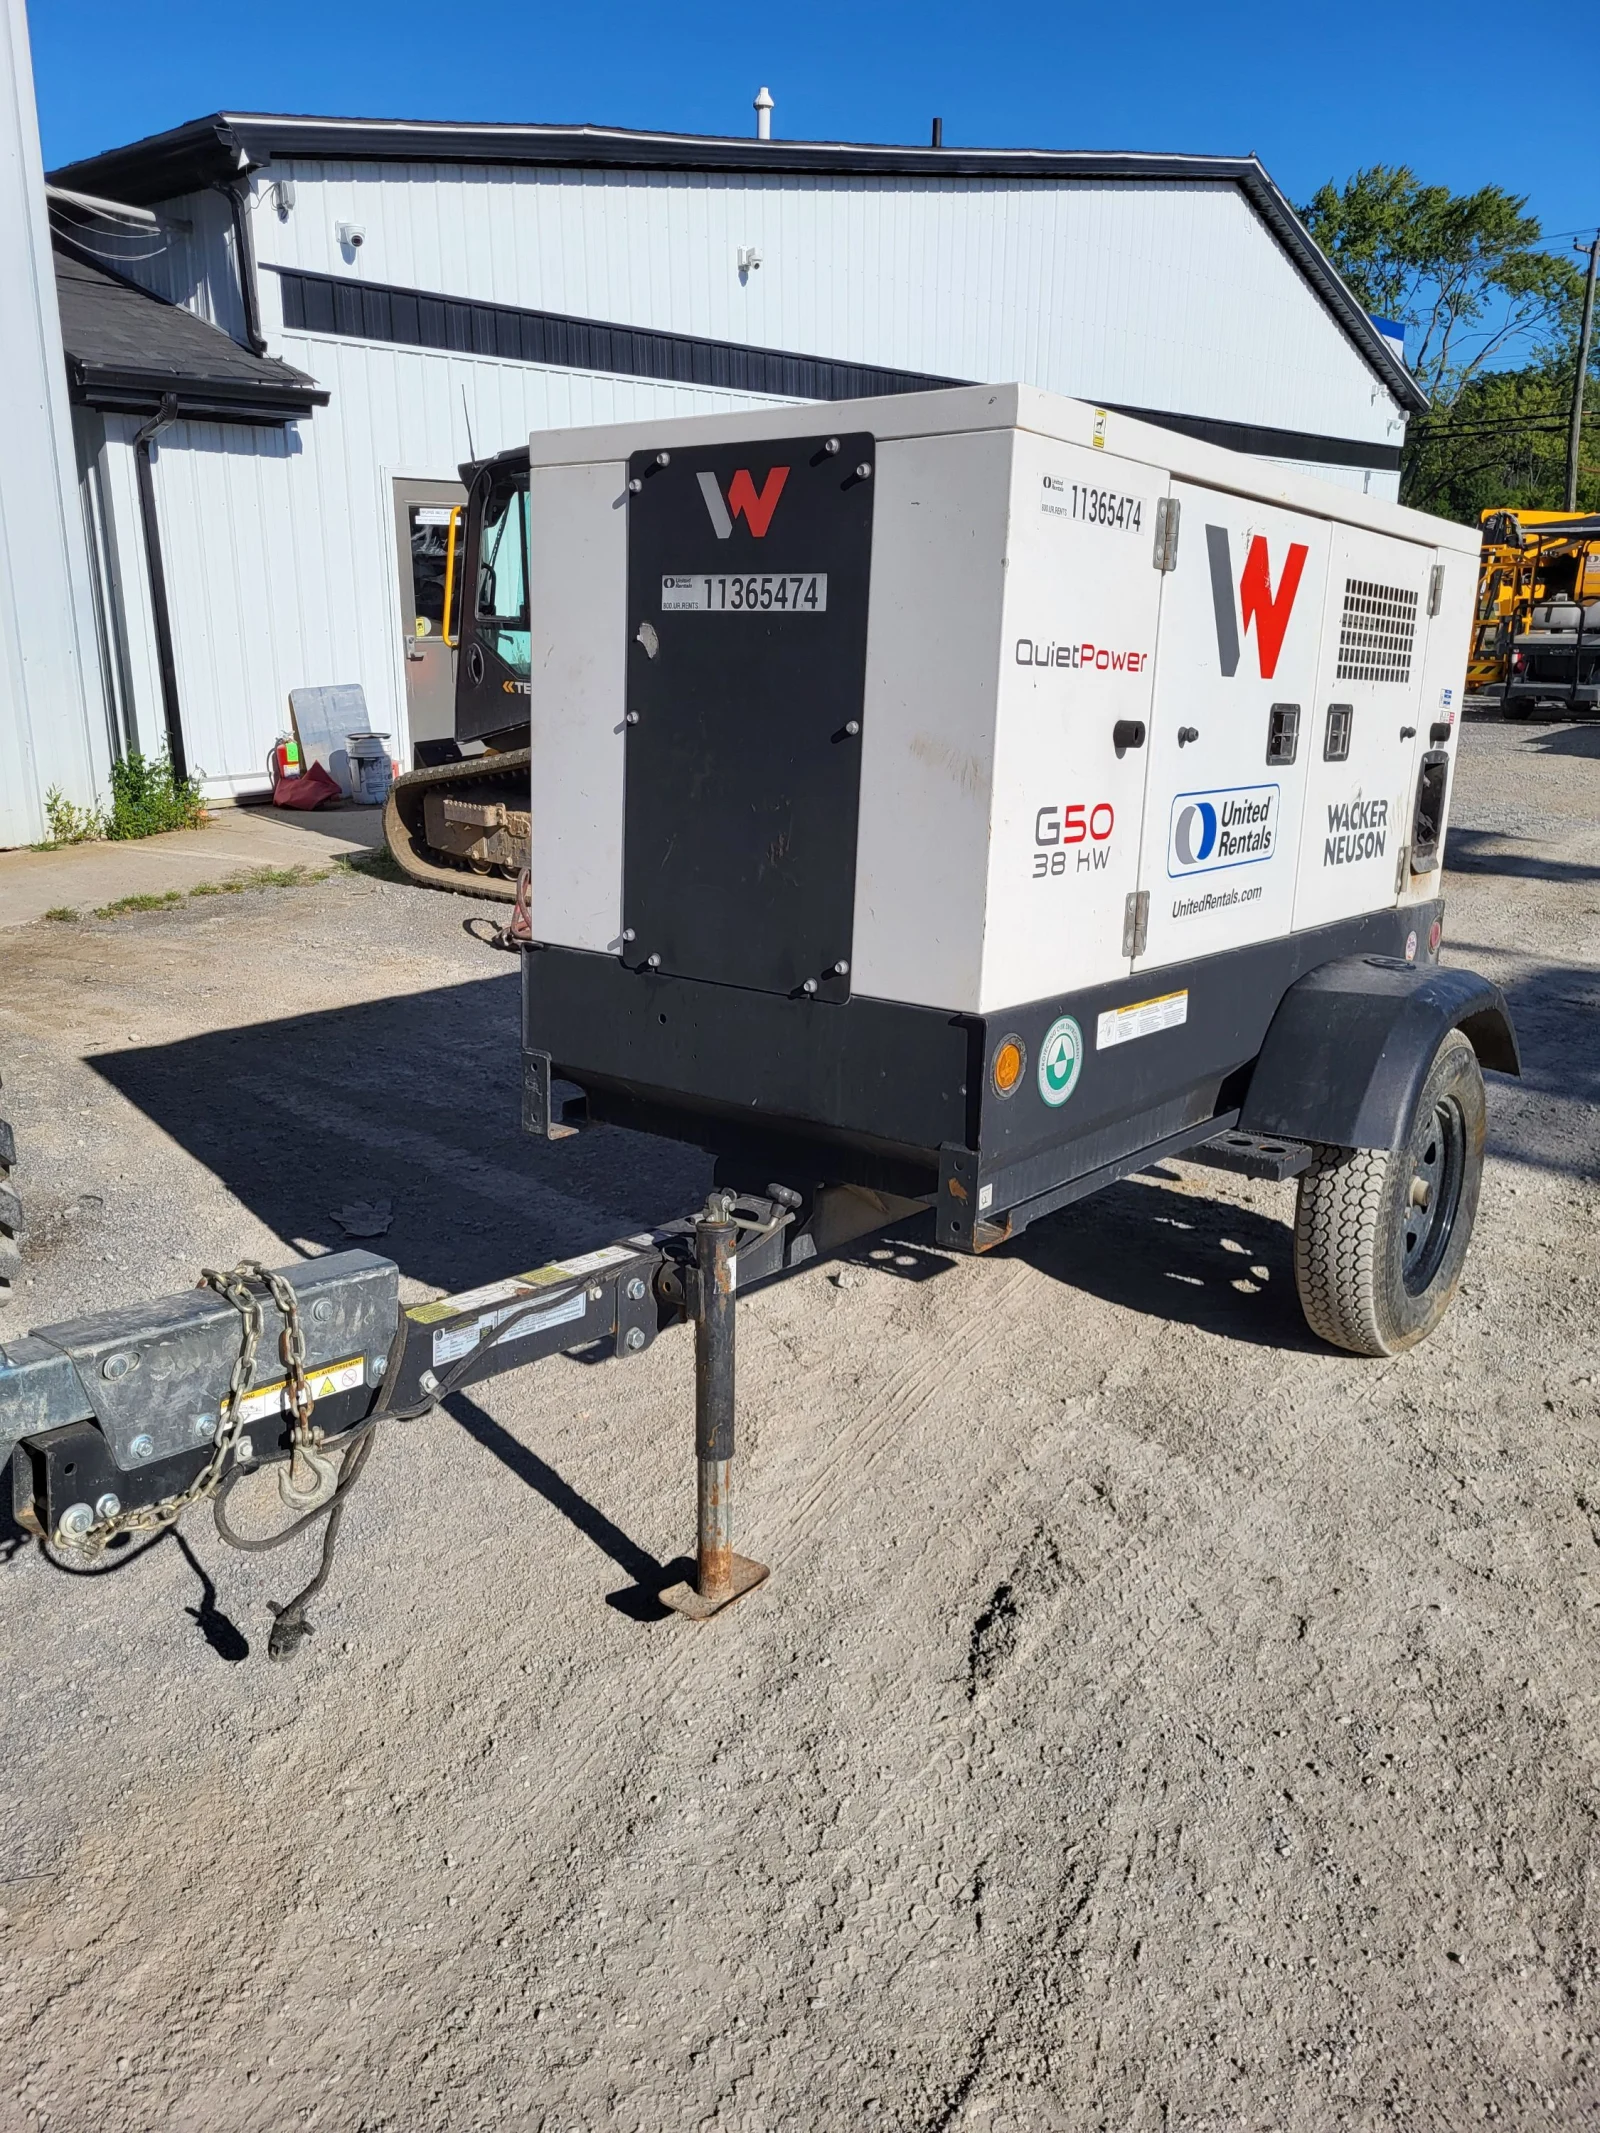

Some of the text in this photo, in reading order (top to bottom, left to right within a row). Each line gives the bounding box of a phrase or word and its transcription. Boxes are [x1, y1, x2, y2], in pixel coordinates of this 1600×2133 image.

[1051, 478, 1064, 487] United
[1072, 485, 1142, 532] 11365474
[663, 602, 699, 610] 800.UR.RENTS
[704, 577, 818, 610] 11365474
[1015, 638, 1147, 673] QuietPower
[1035, 803, 1114, 847] G50
[1221, 796, 1271, 828] United
[1328, 799, 1388, 833] WACKER
[1218, 825, 1272, 858] Rentals
[1323, 830, 1386, 867] NEUSON
[1032, 851, 1066, 879] 38
[1172, 886, 1262, 919] UnitedRentals.com
[321, 1359, 363, 1376] AVERTISSEMENT
